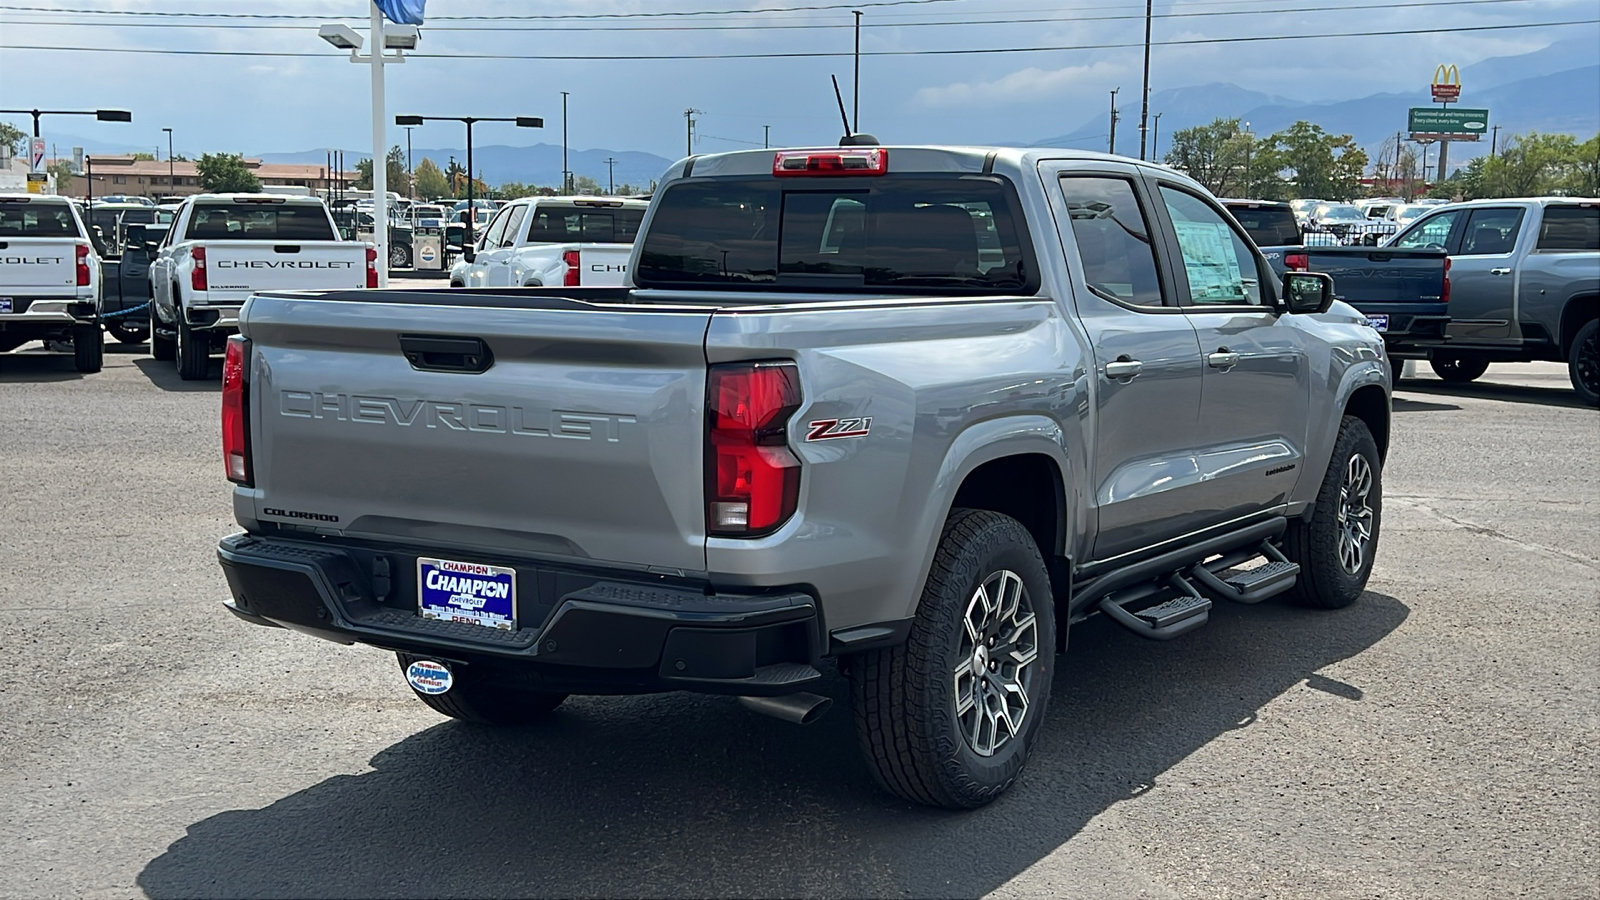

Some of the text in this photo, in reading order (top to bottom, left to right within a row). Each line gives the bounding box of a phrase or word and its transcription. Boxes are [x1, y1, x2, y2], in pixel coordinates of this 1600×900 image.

[218, 260, 355, 269] CHEVROLET
[280, 388, 637, 442] CHEVROLET
[805, 416, 872, 442] Z71
[263, 507, 339, 522] COLORADO
[443, 562, 488, 575] CHAMPION
[426, 569, 509, 599] CHAMPION
[451, 596, 484, 606] CHEVROLET
[410, 665, 449, 680] CHAMPION
[417, 678, 442, 687] CHEVROLET
